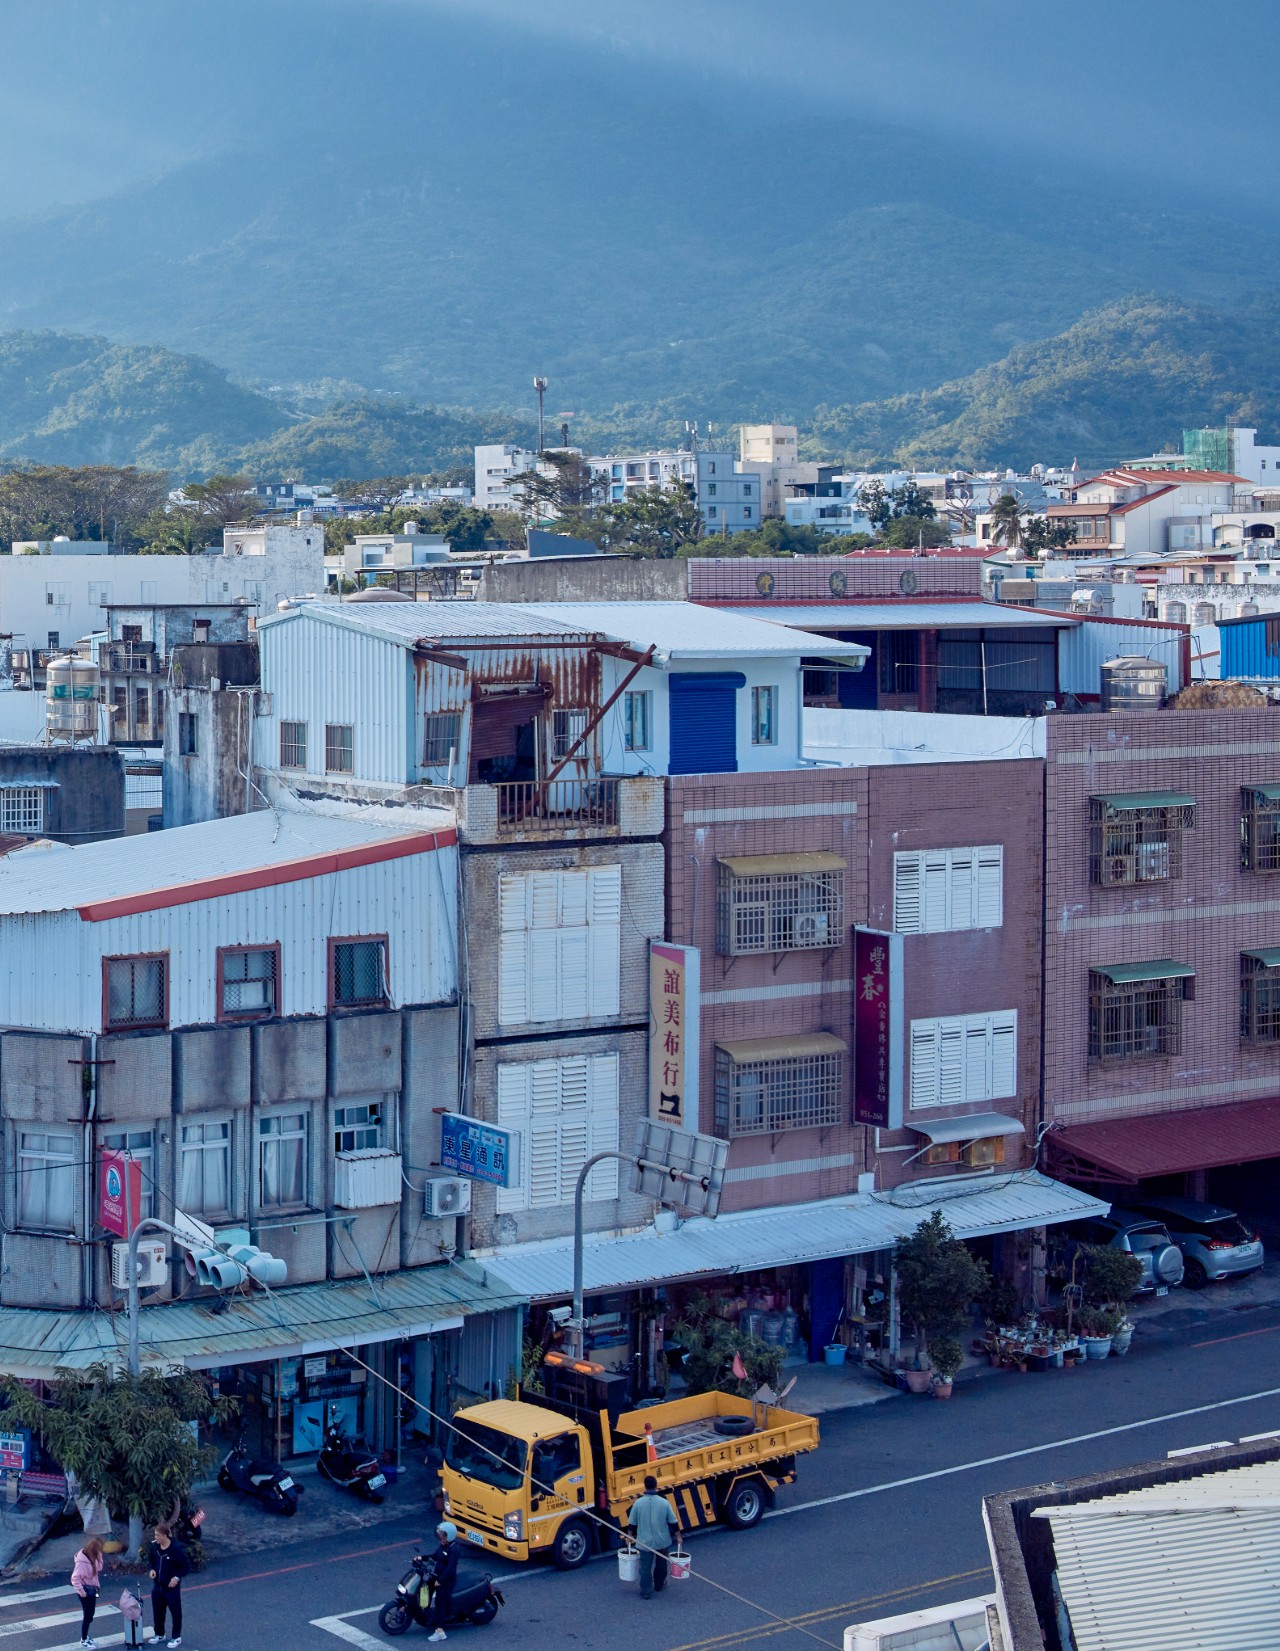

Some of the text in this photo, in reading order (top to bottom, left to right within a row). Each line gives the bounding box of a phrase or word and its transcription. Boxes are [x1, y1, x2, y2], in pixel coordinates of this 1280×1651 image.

[663, 968, 680, 1087] 誼美布行
[443, 1134, 505, 1171] 東星通訊
